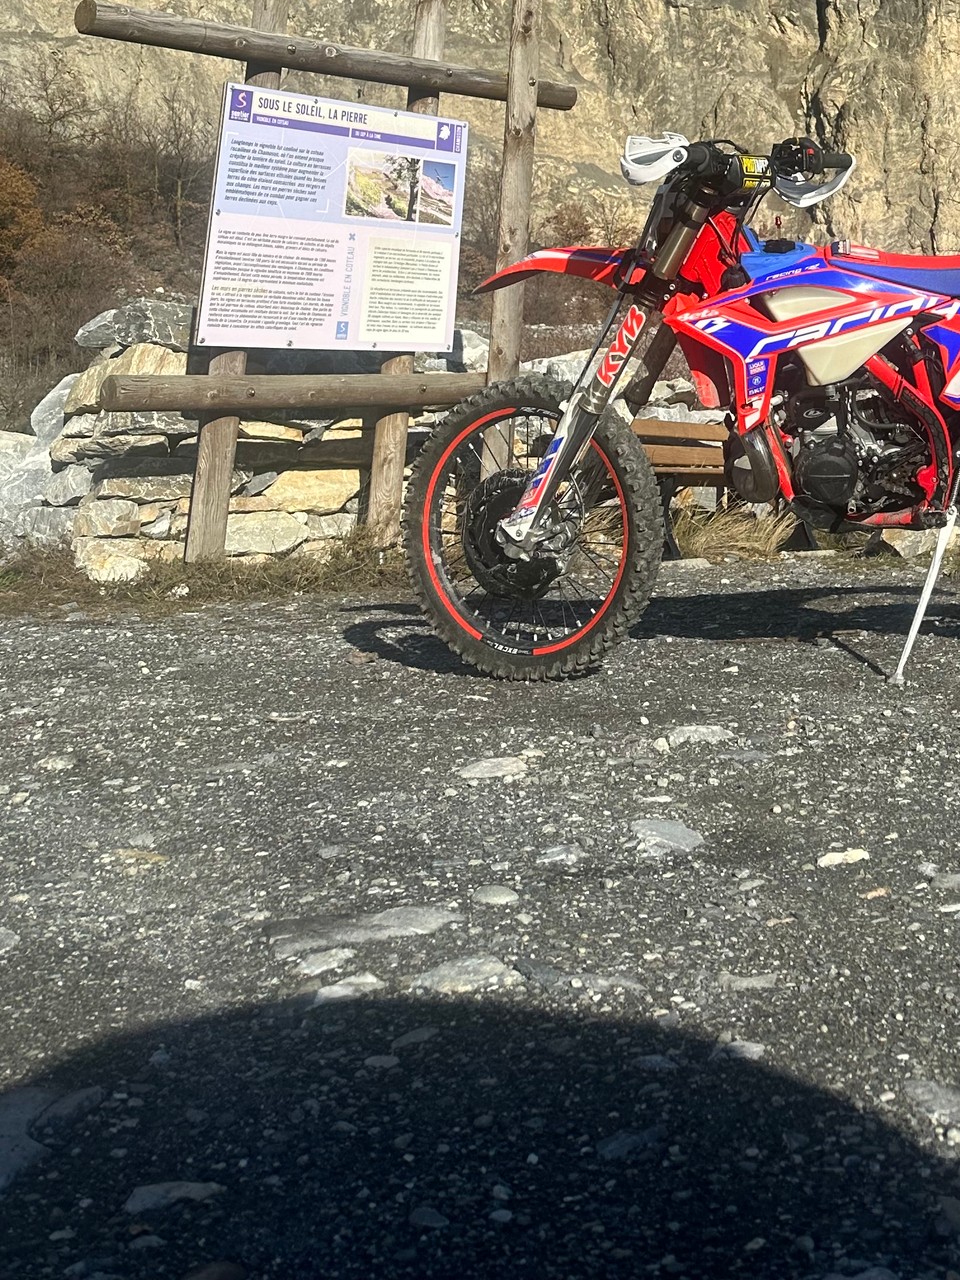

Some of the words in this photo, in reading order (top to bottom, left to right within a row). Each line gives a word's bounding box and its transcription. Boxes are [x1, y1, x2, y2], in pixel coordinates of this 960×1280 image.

[257, 96, 279, 110] SOUS
[282, 100, 292, 112] LE
[295, 102, 325, 118] SOLEIL,
[328, 108, 338, 120] LA
[340, 110, 367, 124] PIERRE
[345, 246, 354, 272] COTEAU
[344, 274, 352, 282] EN
[340, 286, 350, 316] VIGNOBLE
[597, 304, 647, 389] KYB
[494, 642, 518, 654] EXCEL
